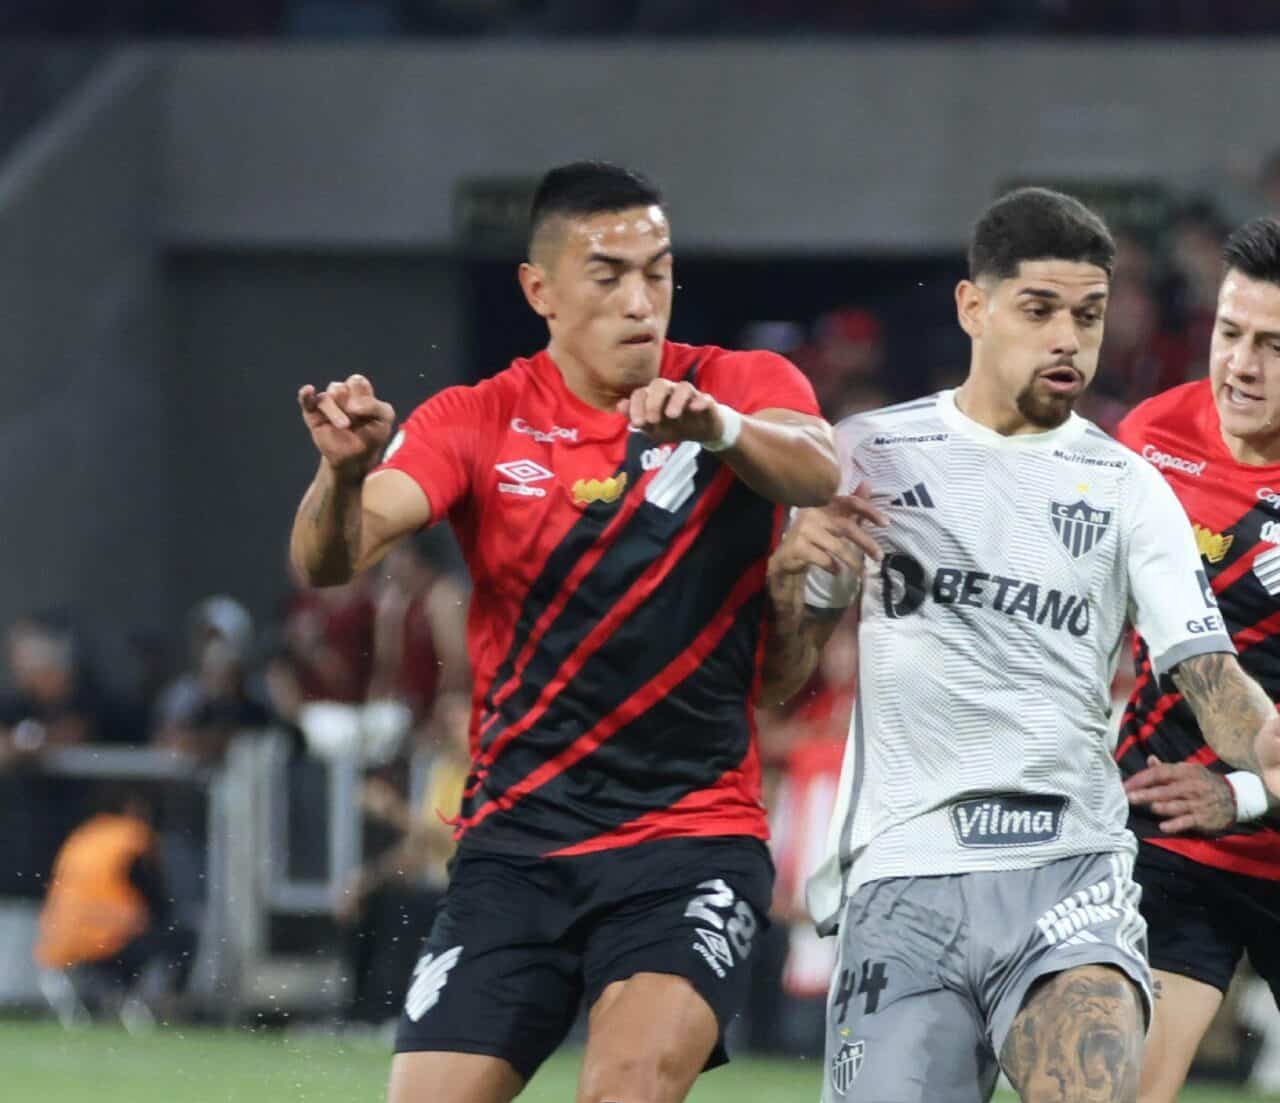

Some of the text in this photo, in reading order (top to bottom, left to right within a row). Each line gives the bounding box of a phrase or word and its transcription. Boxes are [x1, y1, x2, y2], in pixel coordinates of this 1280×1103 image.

[1142, 444, 1206, 476] Copacol
[1057, 506, 1105, 523] CAM
[932, 567, 1092, 637] BETANO
[956, 803, 1054, 837] Vilma
[684, 878, 757, 960] 28
[833, 959, 889, 1025] 44
